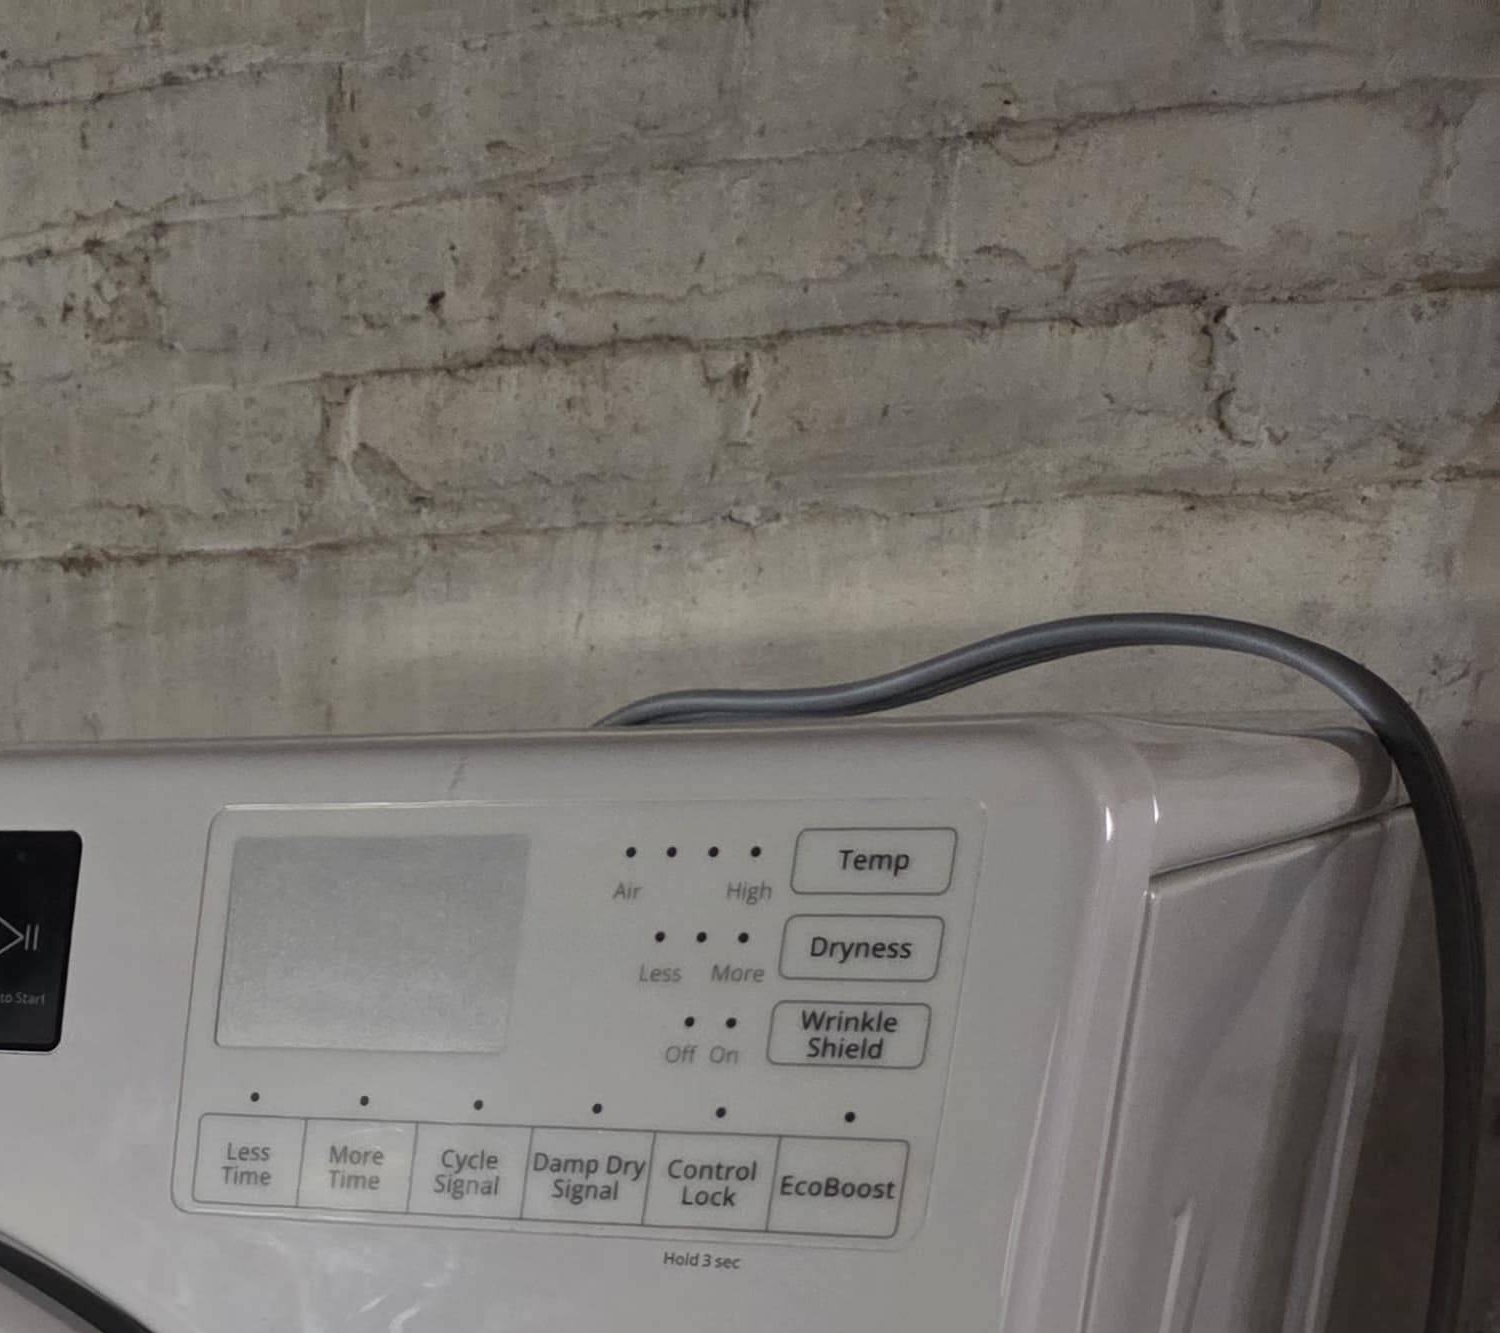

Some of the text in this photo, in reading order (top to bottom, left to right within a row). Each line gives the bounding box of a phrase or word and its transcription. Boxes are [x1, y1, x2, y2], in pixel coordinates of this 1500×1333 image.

[838, 849, 910, 877] Temp
[613, 881, 772, 905] Air High
[810, 936, 913, 964] Dryness
[639, 964, 765, 983] Less More
[800, 1010, 898, 1033] Wrinkle
[664, 1045, 739, 1064] Off On
[806, 1036, 884, 1060] Shield
[226, 1142, 271, 1161] Less
[329, 1145, 385, 1165] More
[440, 1149, 499, 1174] Cycle
[221, 1165, 271, 1186] Time
[533, 1152, 647, 1181] Damp Dry
[667, 1159, 758, 1182] Control
[328, 1169, 380, 1191] Time
[434, 1173, 500, 1200] Signal
[780, 1175, 895, 1200] EcoBoost
[552, 1180, 619, 1205] Signal
[681, 1186, 737, 1207] Lock
[663, 1251, 741, 1269] Hold 3 sec
